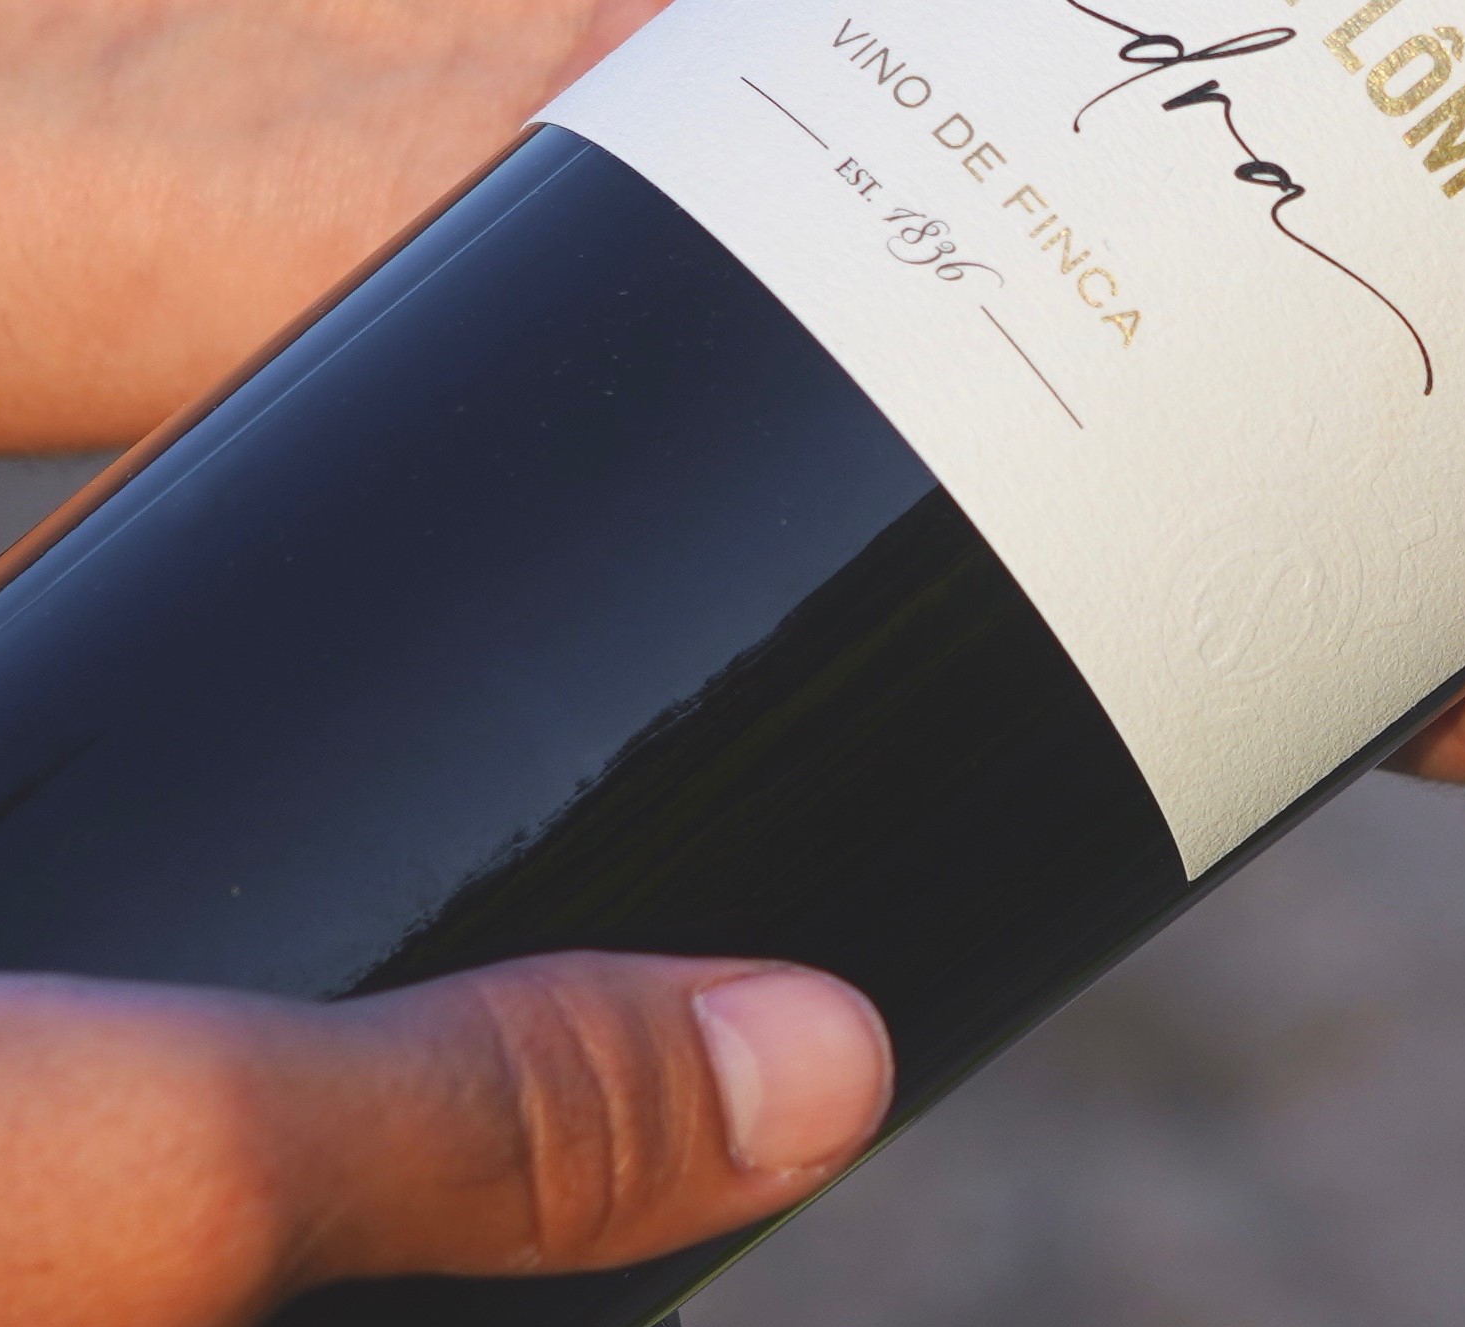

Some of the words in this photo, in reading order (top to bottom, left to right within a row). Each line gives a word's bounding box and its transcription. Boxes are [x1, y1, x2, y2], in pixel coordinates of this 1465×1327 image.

[832, 17, 932, 109] VINO
[931, 112, 1008, 184] DE
[1002, 184, 1142, 348] FINCA
[833, 156, 883, 203] EST.
[881, 207, 1005, 288] 1836
